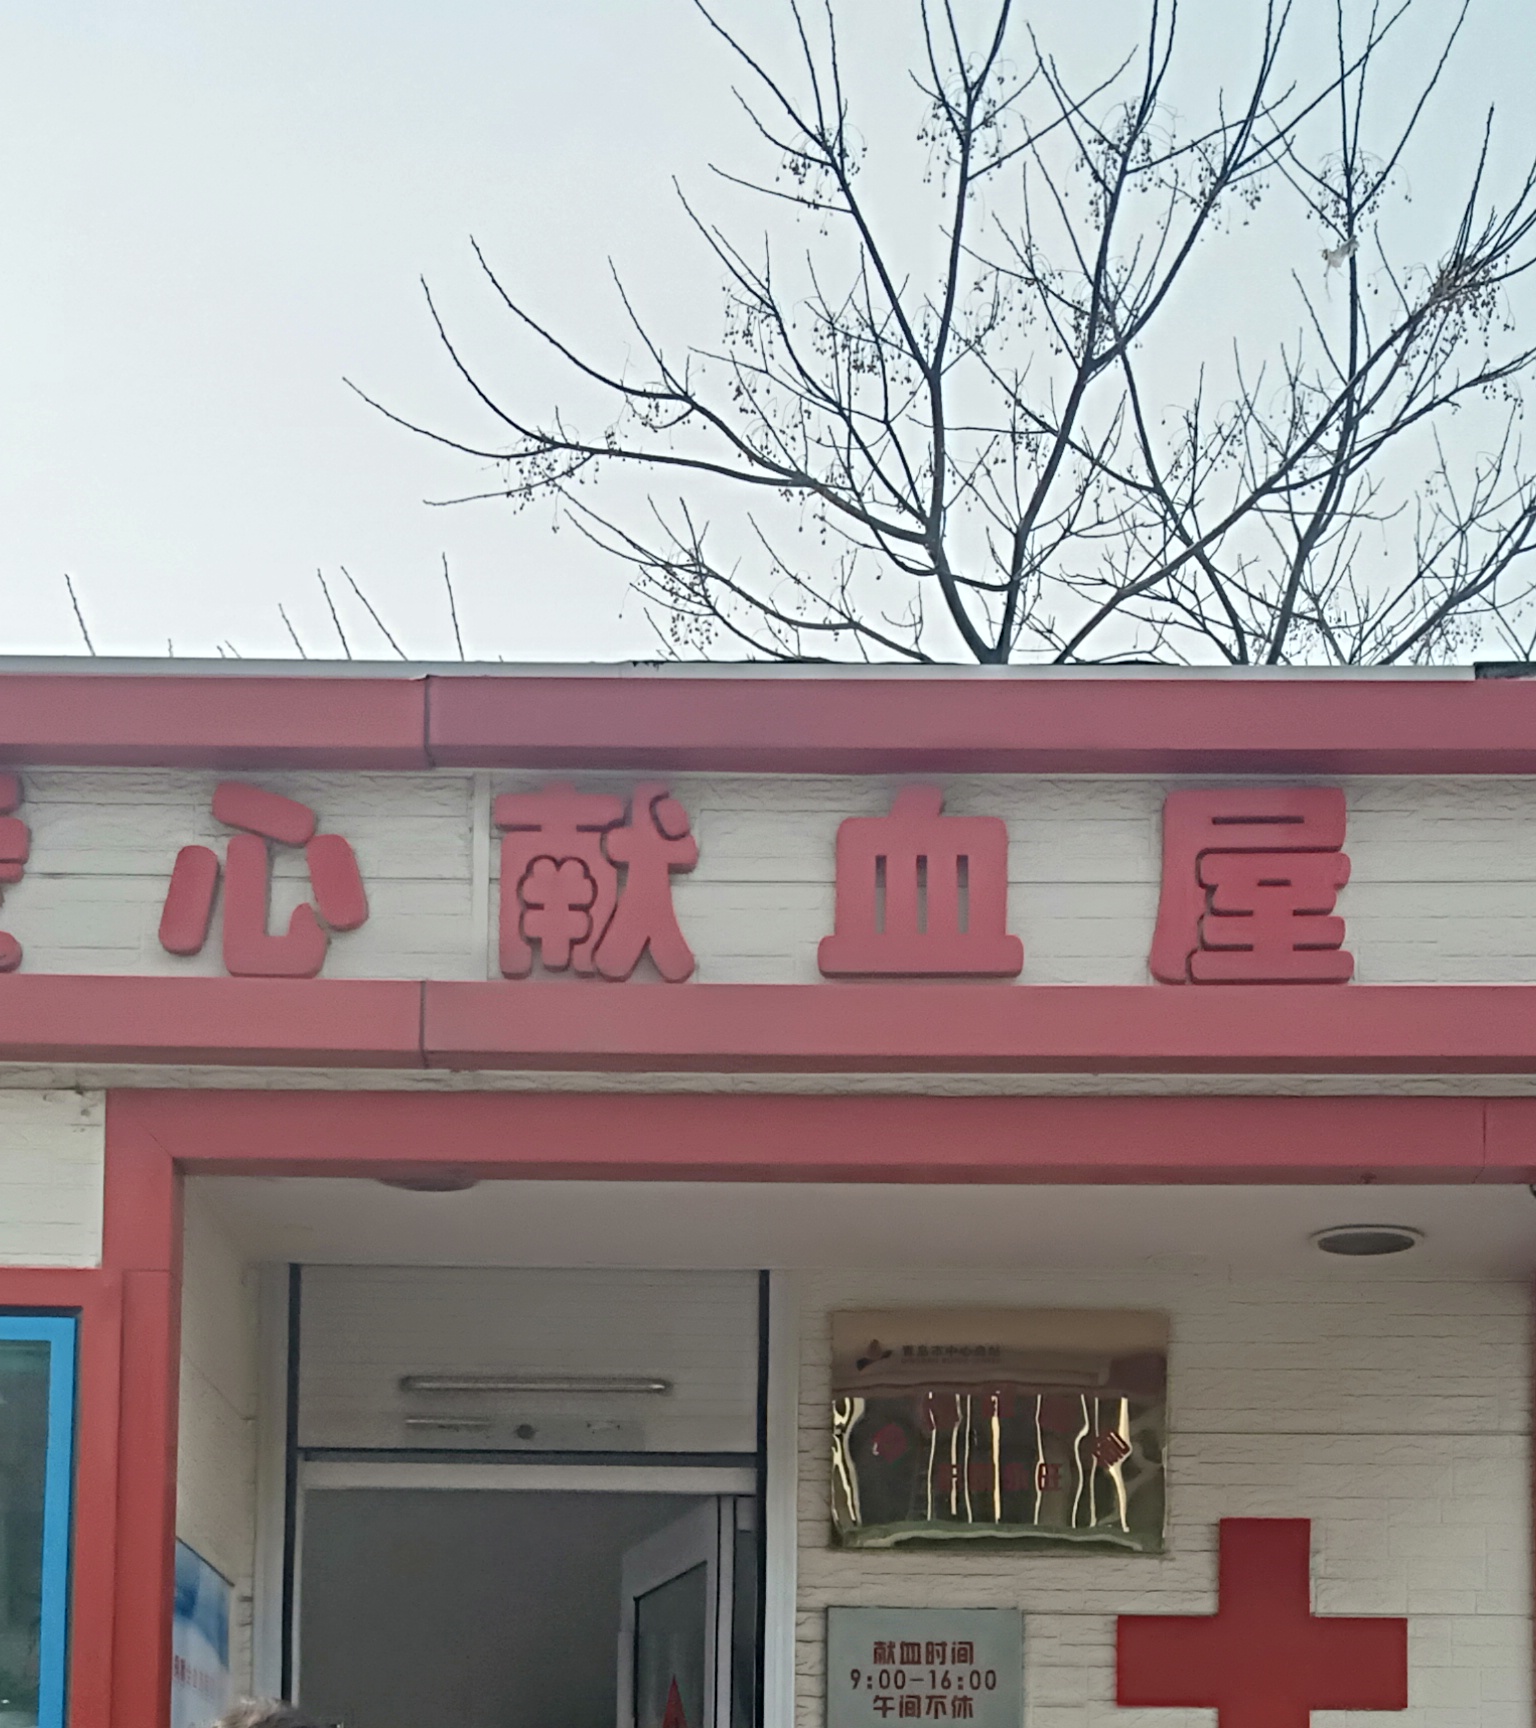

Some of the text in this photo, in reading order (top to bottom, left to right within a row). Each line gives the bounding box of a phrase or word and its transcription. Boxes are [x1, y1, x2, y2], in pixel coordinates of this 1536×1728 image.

[873, 1641, 975, 1666] 献血时间
[850, 1668, 997, 1690] 9:00-16:00
[873, 1695, 975, 1720] 午间不休
